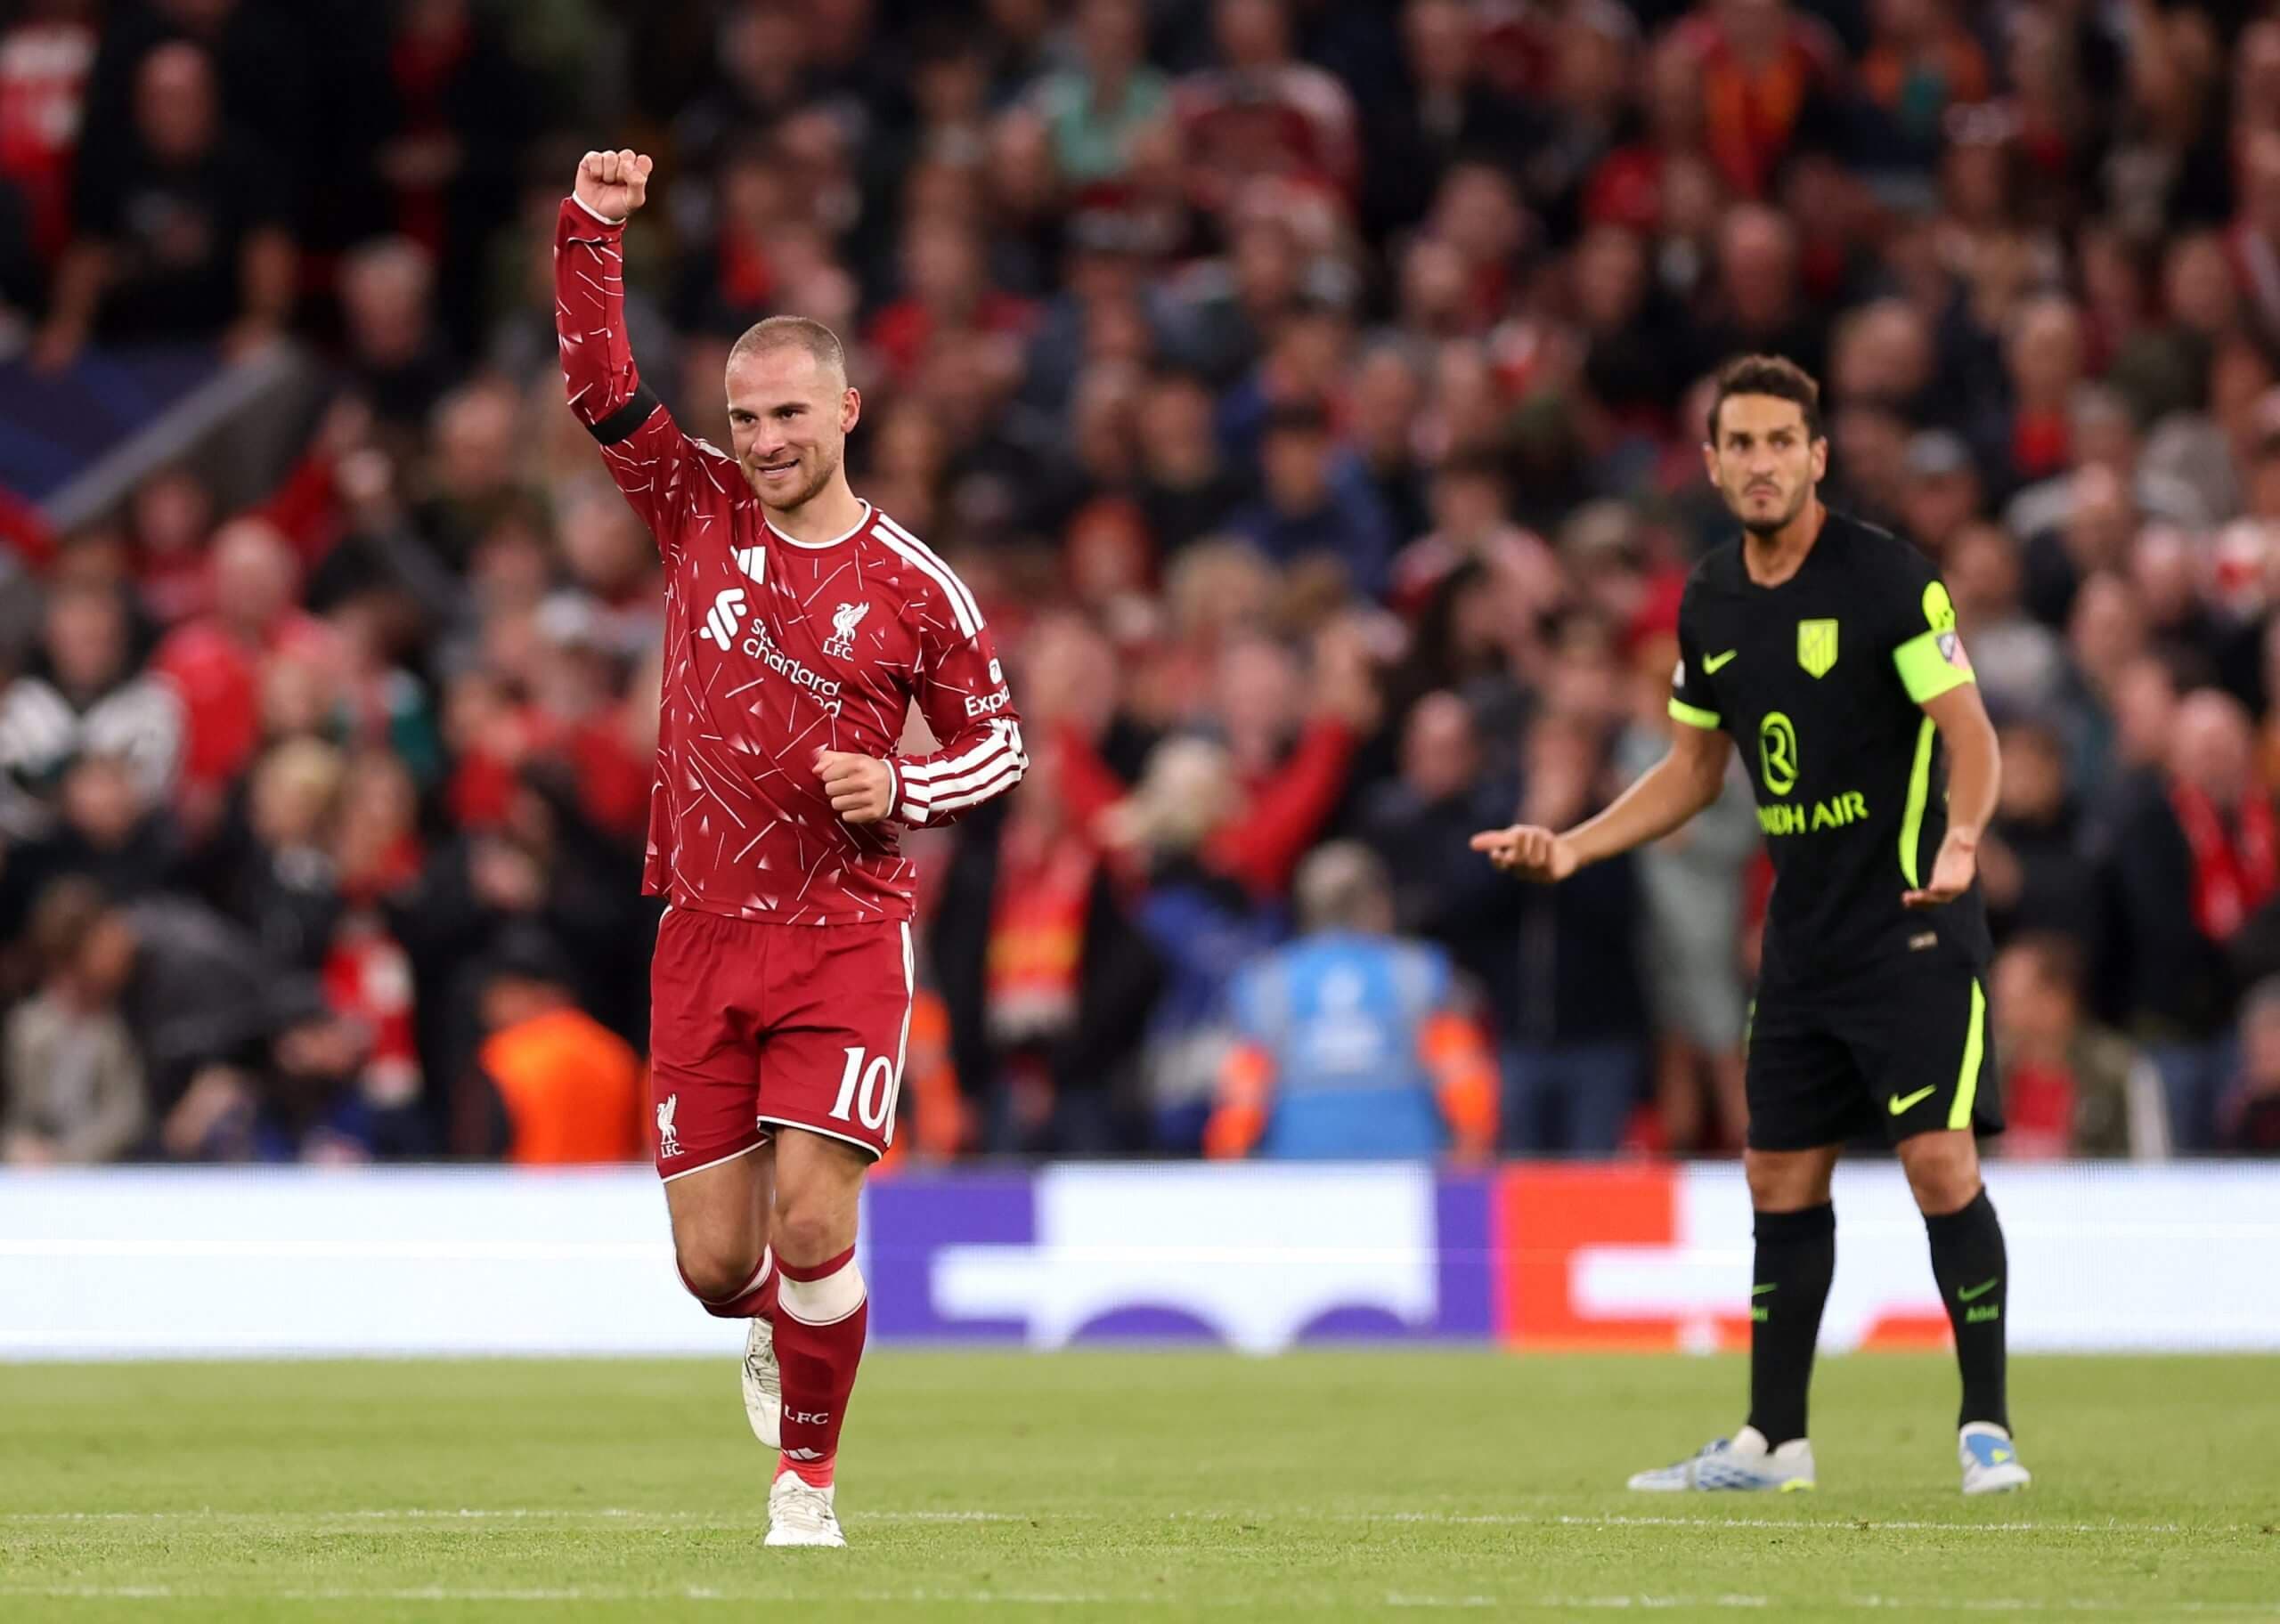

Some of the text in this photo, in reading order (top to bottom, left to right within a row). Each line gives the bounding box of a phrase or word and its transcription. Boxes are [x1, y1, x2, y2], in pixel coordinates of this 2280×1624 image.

[1811, 791, 1869, 832] AIR
[828, 1046, 894, 1131] 10
[785, 1403, 828, 1425] LFC
